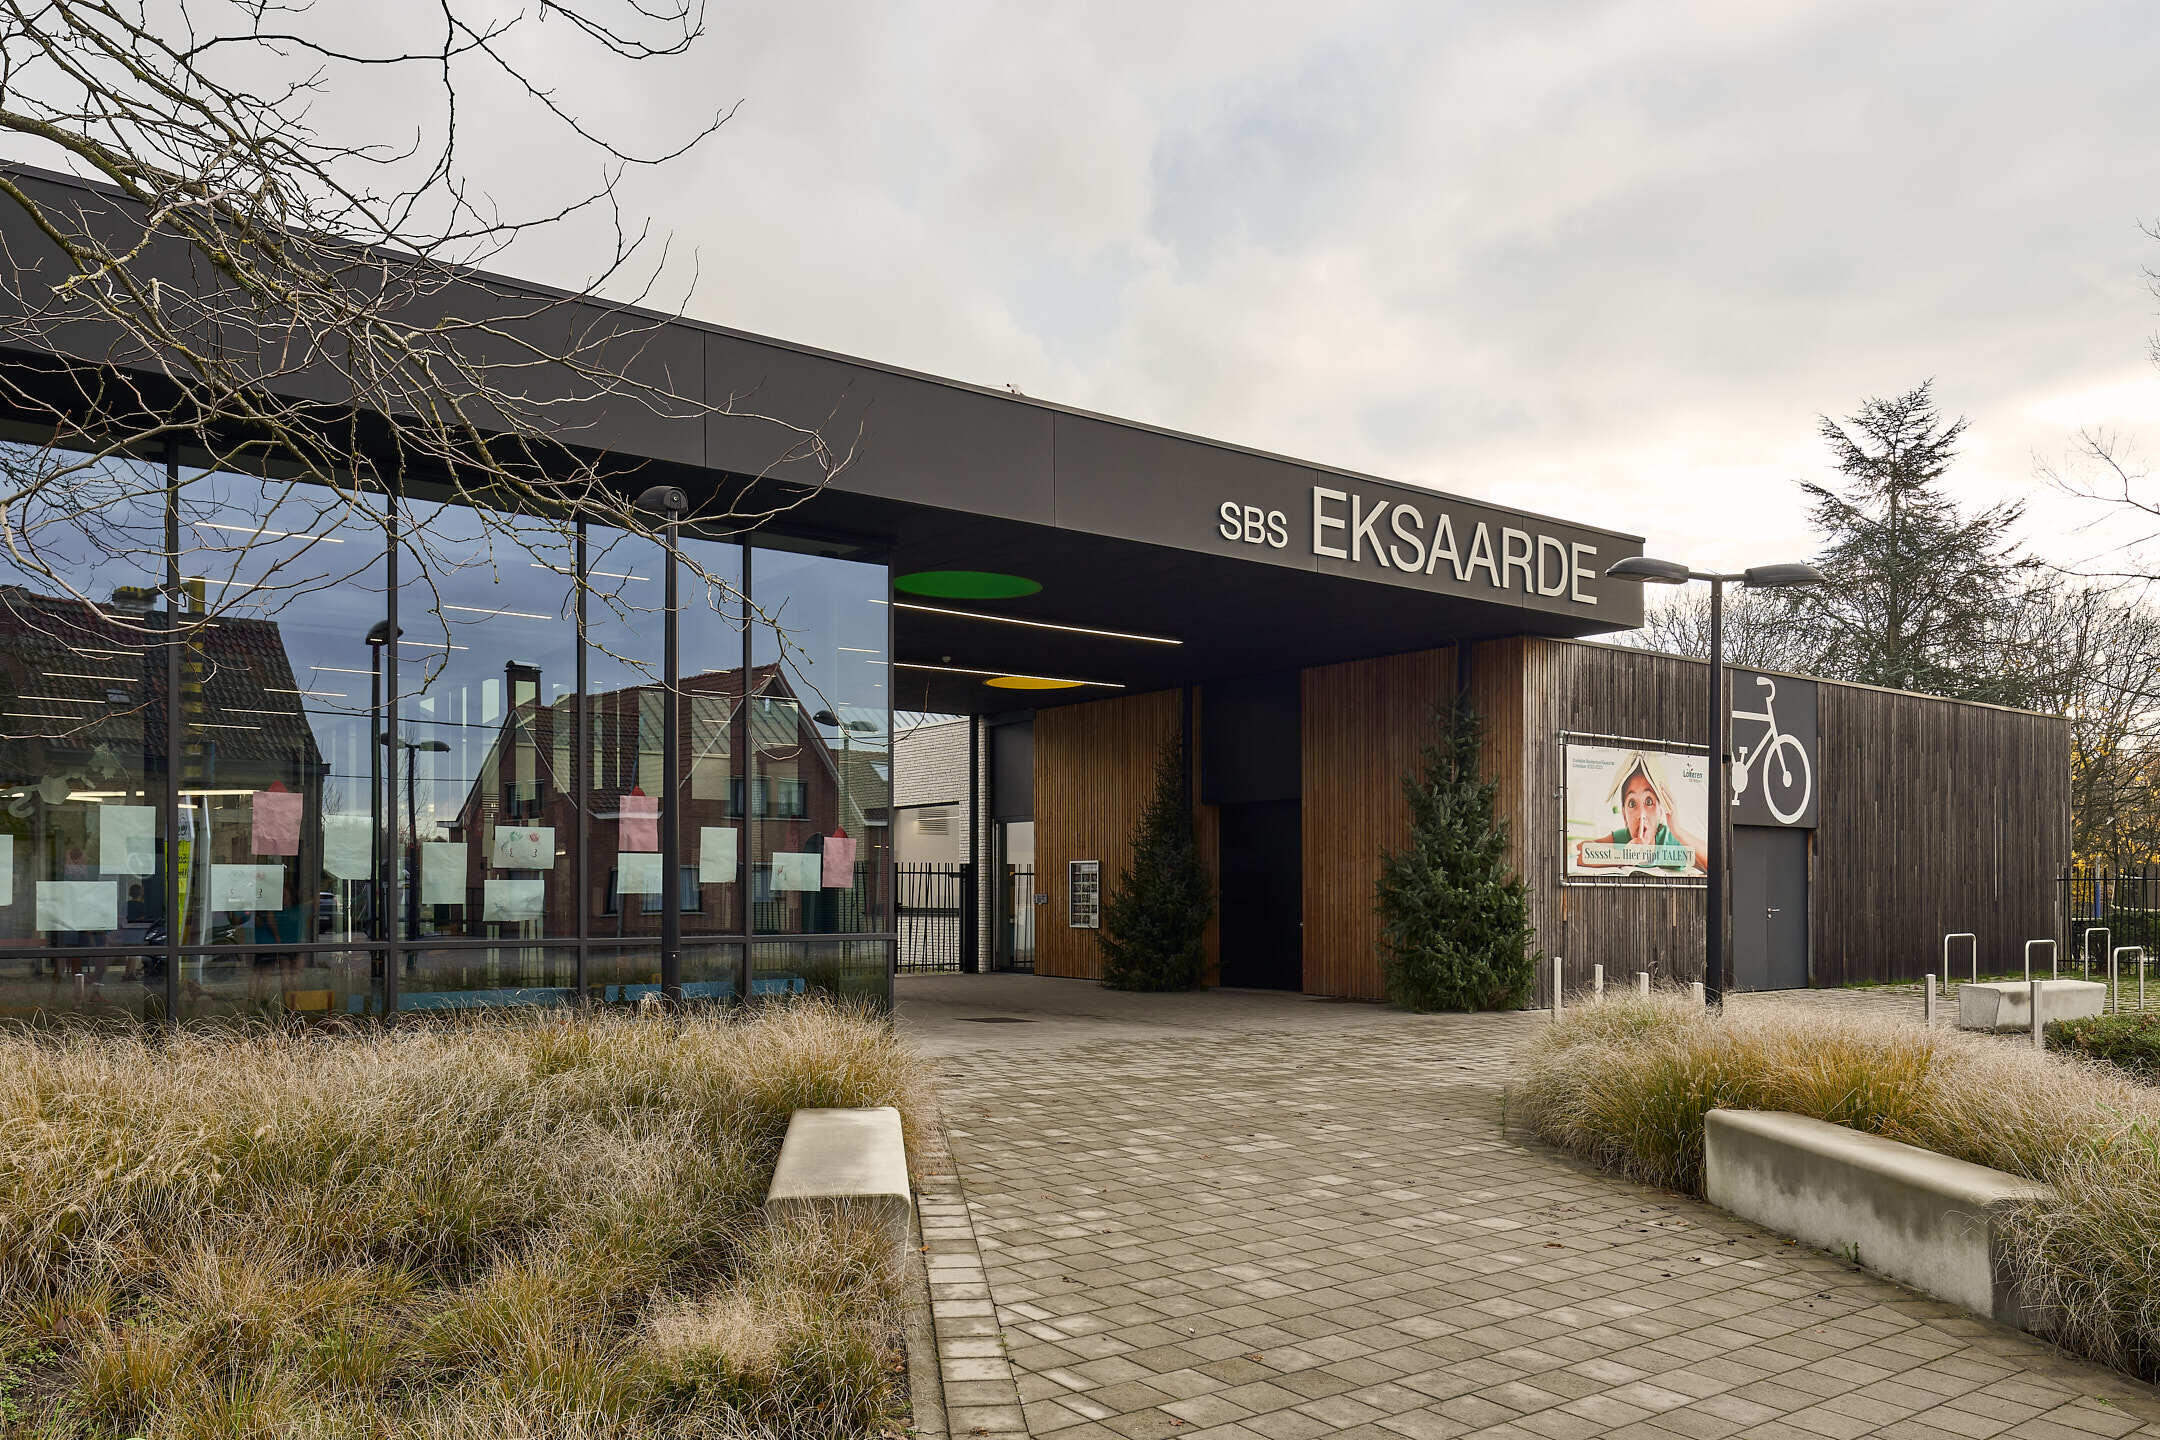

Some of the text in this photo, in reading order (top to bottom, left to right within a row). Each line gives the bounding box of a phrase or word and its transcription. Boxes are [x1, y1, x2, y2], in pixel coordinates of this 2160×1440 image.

[1218, 485, 1598, 605] SBS EKSAARDE
[1622, 848, 1640, 860] Hier
[1642, 849, 1660, 863] rijpt
[1662, 849, 1694, 862] TALENT
